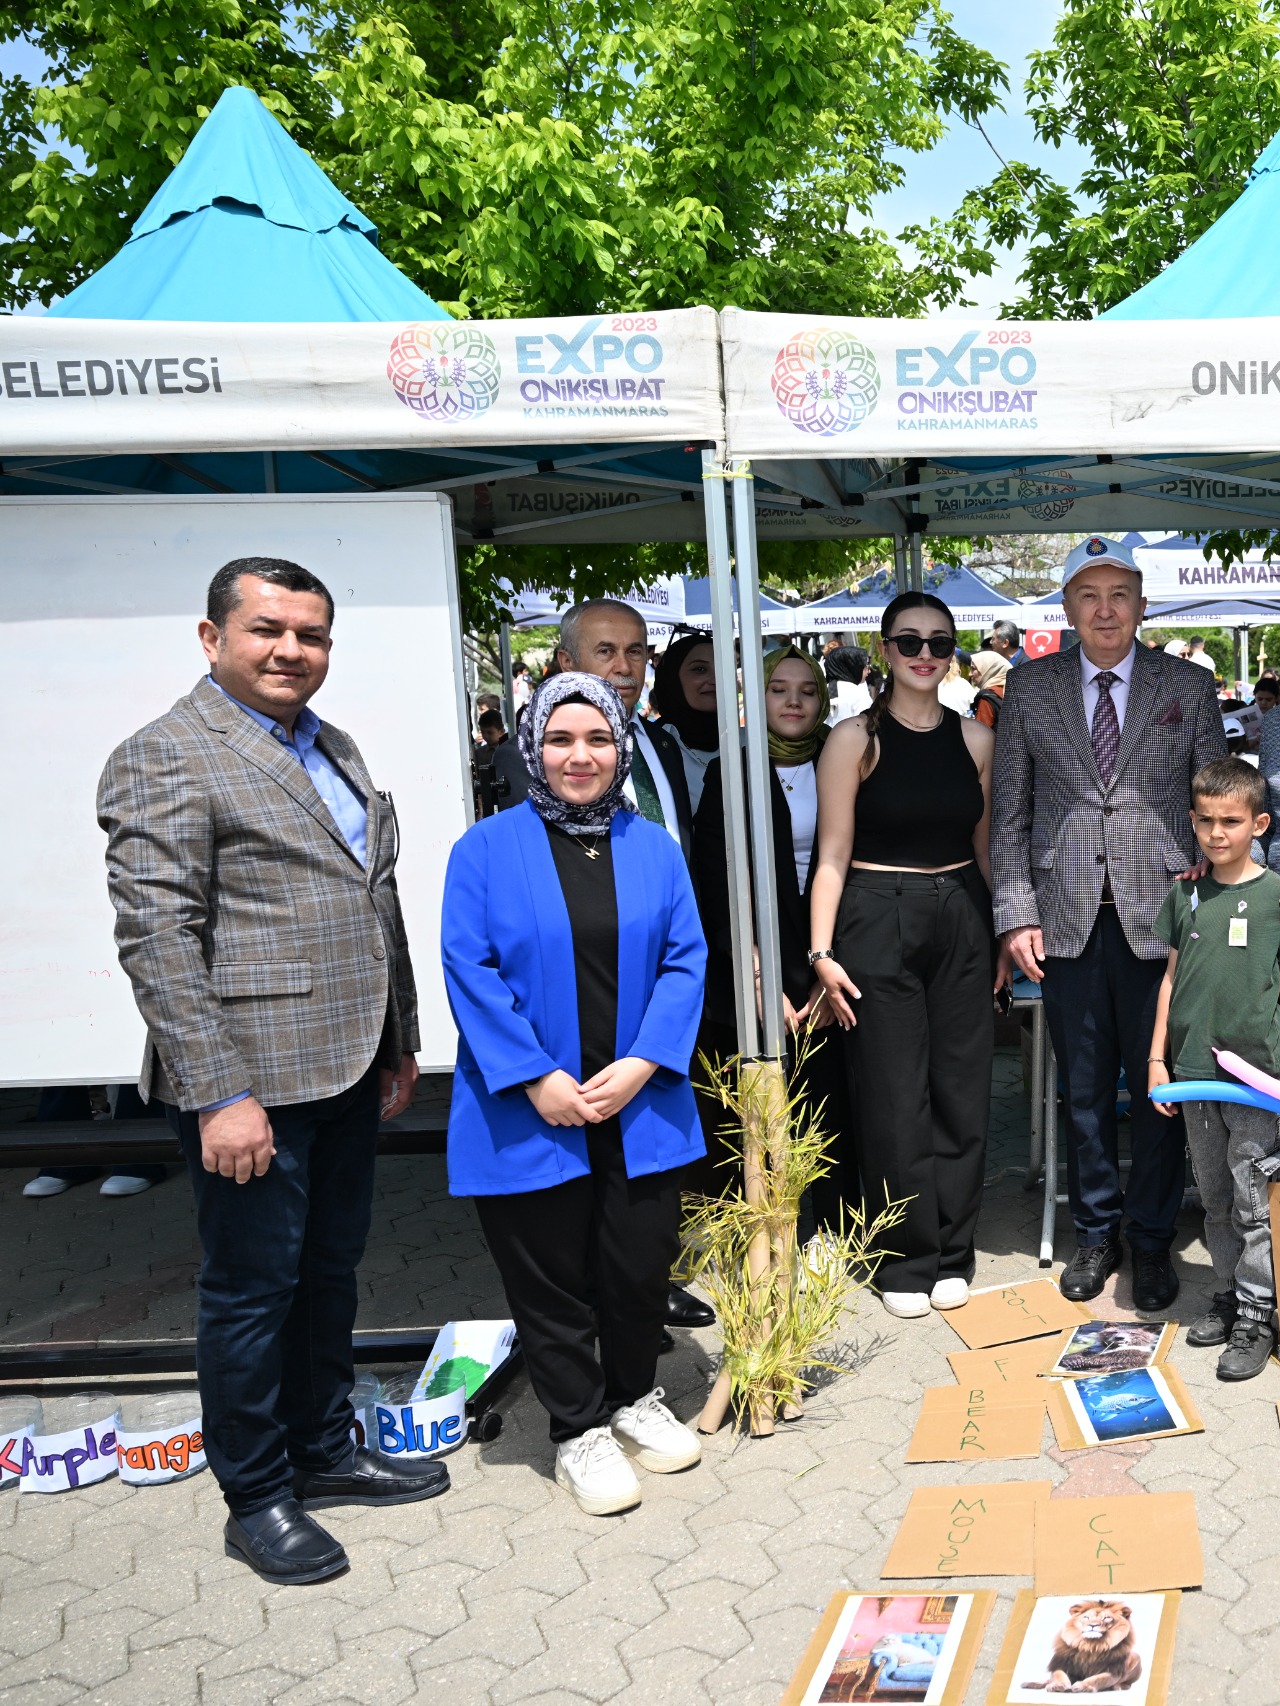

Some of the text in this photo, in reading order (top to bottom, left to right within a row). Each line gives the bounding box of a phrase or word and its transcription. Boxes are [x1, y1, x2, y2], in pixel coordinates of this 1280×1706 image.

[515, 317, 664, 375] EXPO
[612, 317, 658, 332] 2023
[987, 330, 1032, 345] 2023
[0, 356, 223, 399] ELEDiYESi
[895, 330, 1037, 388] EXPO
[523, 405, 669, 419] KAHRAMANMARAŞ
[897, 417, 1039, 431] KAHRAMANMARAŞ
[952, 613, 994, 623] ELEDİYESİ
[375, 1406, 462, 1455] Blue
[960, 1389, 986, 1452] BEAR
[21, 1427, 117, 1488] Purple
[117, 1430, 205, 1473] range
[937, 1498, 987, 1573] MOUSE
[1089, 1513, 1126, 1586] CAT
